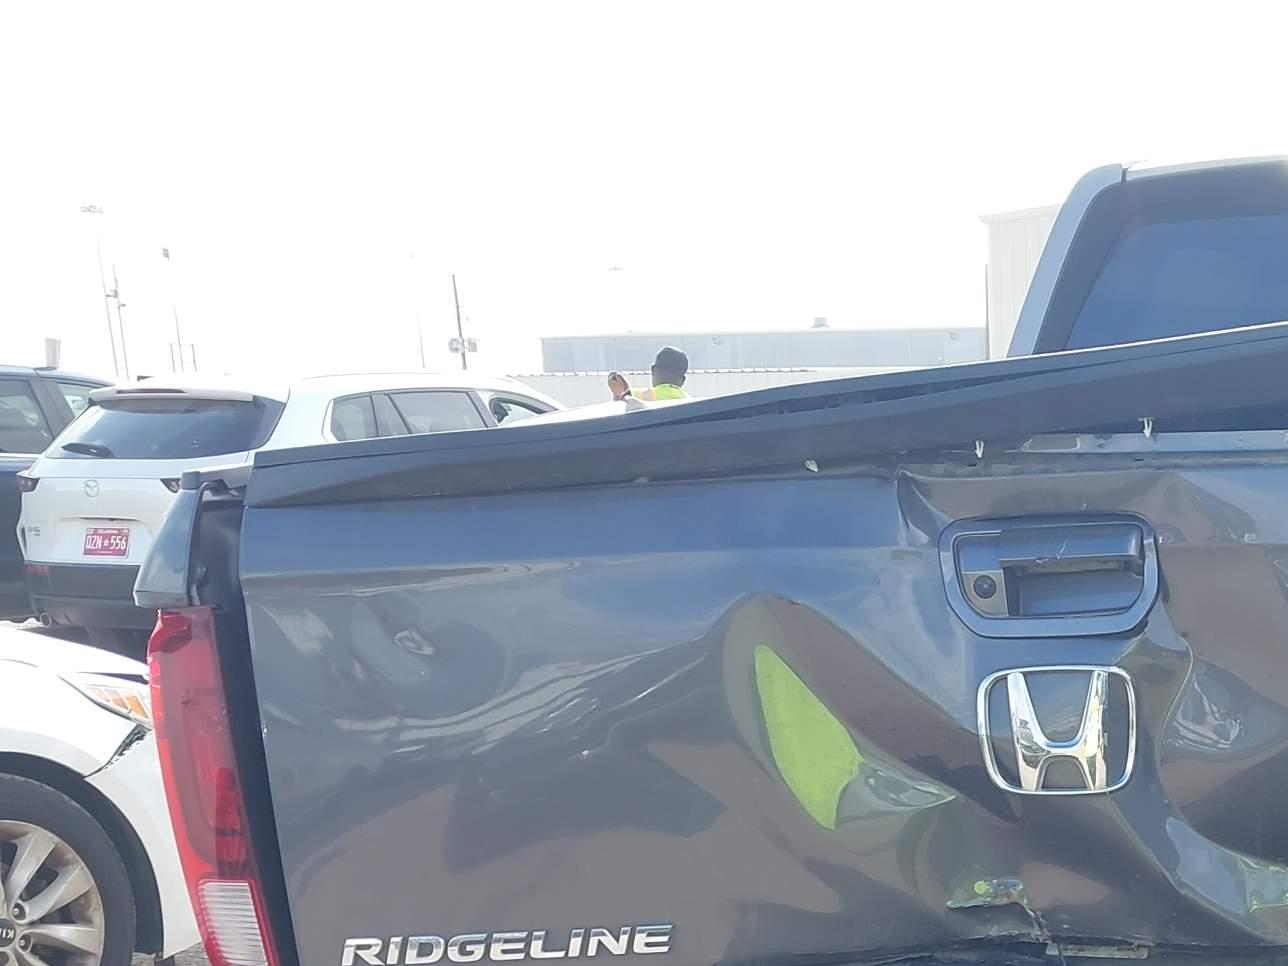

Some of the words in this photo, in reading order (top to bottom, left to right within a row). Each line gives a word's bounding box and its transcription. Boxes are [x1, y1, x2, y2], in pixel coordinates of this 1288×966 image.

[109, 535, 127, 550] 556
[0, 928, 14, 939] KI
[341, 923, 674, 966] RIDGELINE
